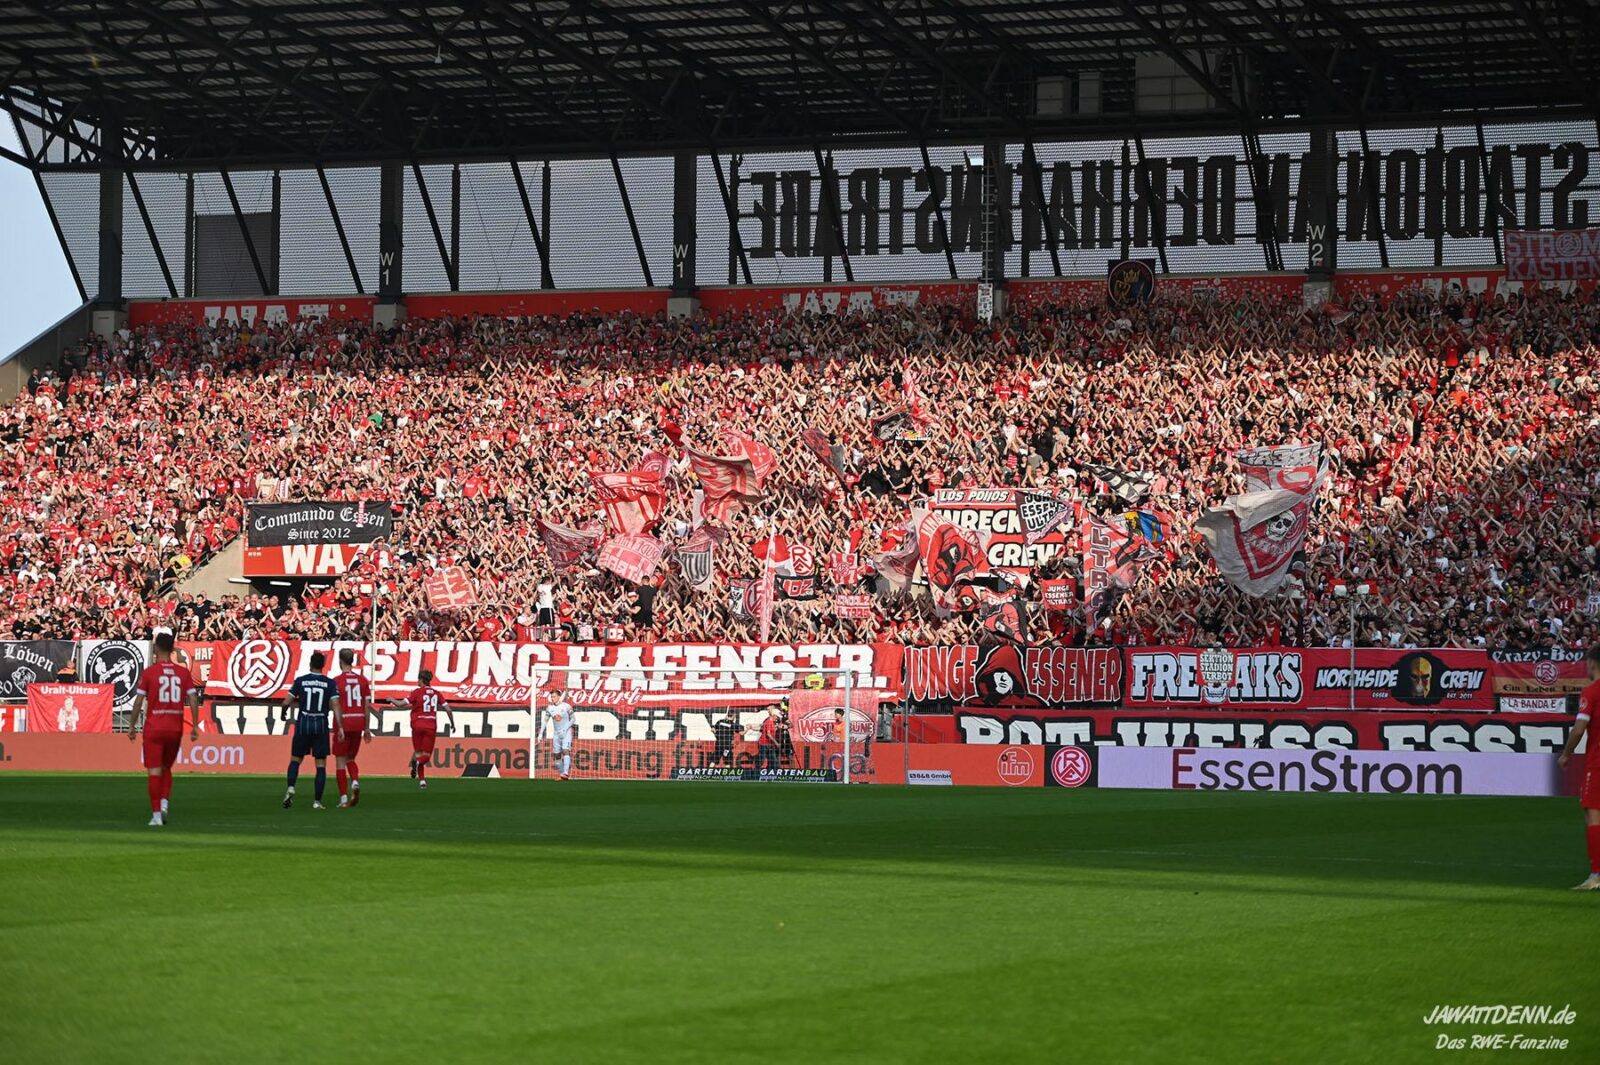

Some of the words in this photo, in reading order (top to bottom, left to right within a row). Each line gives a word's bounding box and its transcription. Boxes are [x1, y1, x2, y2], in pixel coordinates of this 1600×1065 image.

[1309, 225, 1325, 240] W
[380, 252, 394, 266] W
[673, 245, 688, 259] W
[1312, 244, 1324, 260] 2
[383, 269, 390, 285] 1
[677, 262, 684, 278] 1
[940, 490, 964, 502] LOS
[254, 507, 335, 531] Commando
[288, 528, 319, 540] Since
[322, 528, 350, 539] 2012
[101, 640, 127, 649] GARDE
[3, 643, 54, 672] Löwen
[898, 645, 979, 703] JUNGE
[1025, 646, 1123, 703] ESSENER
[1315, 669, 1400, 688] NORTHSIDE
[1439, 671, 1484, 690] CREW
[41, 685, 99, 695] Uralt-Ultras
[158, 675, 181, 703] 26
[345, 684, 362, 707] 14
[304, 687, 325, 711] 17
[422, 694, 438, 712] 24
[1521, 700, 1549, 708] BANDA
[678, 768, 744, 776] GARTENBAU
[760, 769, 827, 777] GARTENBAU
[1172, 749, 1462, 794] EssenStrom
